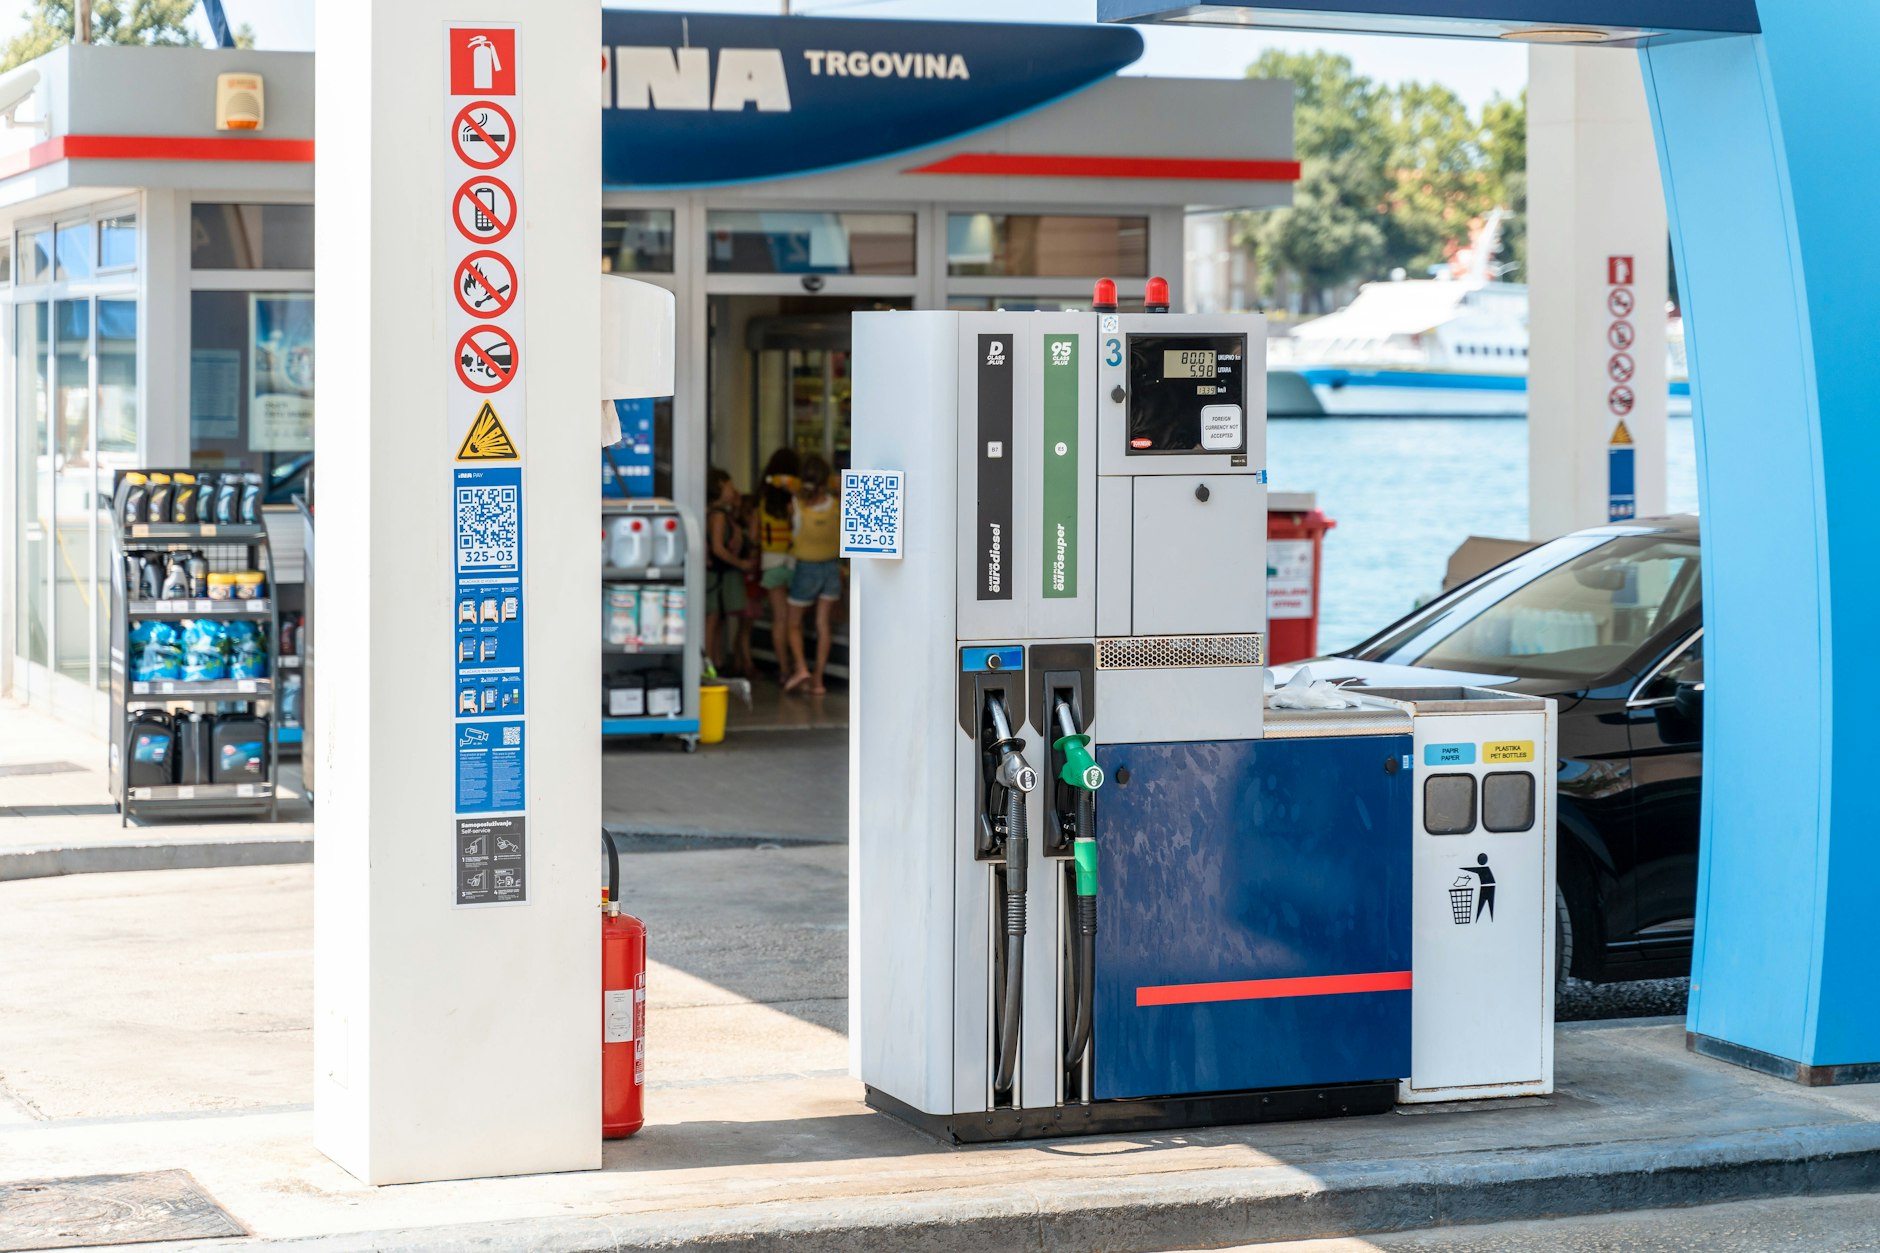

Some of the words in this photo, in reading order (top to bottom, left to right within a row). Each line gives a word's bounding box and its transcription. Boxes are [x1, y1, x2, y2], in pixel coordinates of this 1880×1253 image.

[804, 49, 970, 80] TRGOVINA
[989, 341, 1004, 356] D
[1051, 341, 1073, 357] 95
[1105, 339, 1123, 367] 3
[849, 534, 895, 545] 325-03
[465, 550, 513, 563] 325-03
[989, 523, 1000, 593] eurodiesel
[1057, 523, 1067, 591] eurosuper
[461, 820, 512, 828] Samoposluživanje
